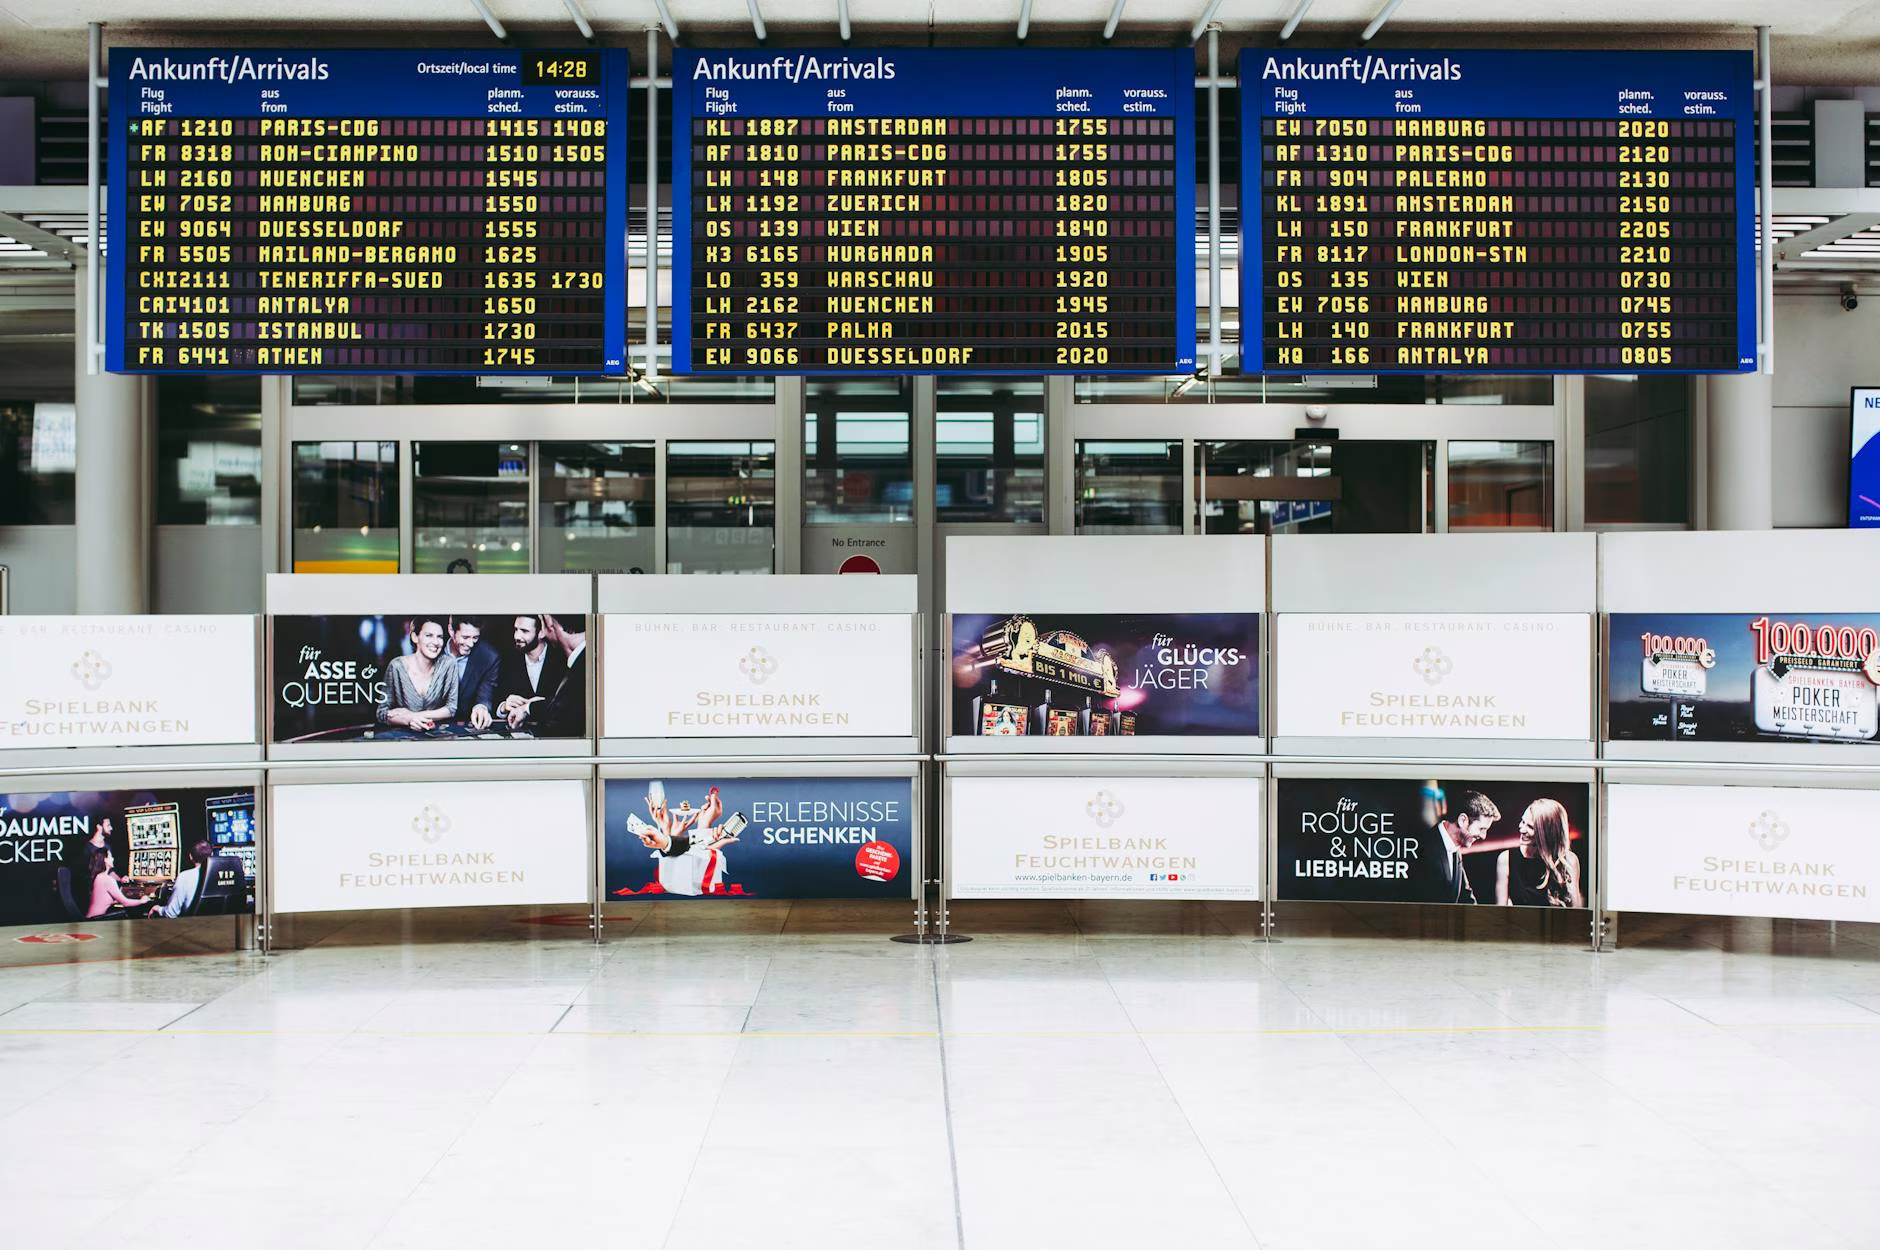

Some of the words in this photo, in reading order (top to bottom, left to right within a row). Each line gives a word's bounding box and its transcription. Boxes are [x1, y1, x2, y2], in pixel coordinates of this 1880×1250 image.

[129, 55, 329, 82] Ankunft/Arrivals
[417, 61, 489, 76] Ortszeit/local
[492, 62, 517, 75] time
[536, 61, 587, 78] 14:28
[693, 54, 896, 82] Ankunft/Arrivals
[1262, 55, 1462, 82] Ankunft/Arrivals
[141, 86, 165, 102] Flug
[261, 89, 280, 99] aus
[487, 87, 525, 101] planm.
[554, 89, 600, 99] vorauss.
[705, 87, 729, 101] Flug
[827, 89, 846, 98] aus
[1056, 86, 1093, 100] planm.
[1123, 89, 1168, 98] vorauss.
[1274, 86, 1298, 101] Flug
[1394, 89, 1414, 99] aus
[1618, 88, 1655, 103] planm.
[1683, 91, 1728, 101] vorauss.
[141, 101, 173, 116] Flight
[260, 101, 288, 113] from
[487, 101, 522, 113] sched.
[554, 101, 588, 113] estim.
[705, 101, 738, 116] Flight
[827, 100, 854, 112] from
[1056, 100, 1091, 112] sched.
[1123, 101, 1156, 112] estim.
[1275, 100, 1307, 115] Flight
[1395, 101, 1422, 113] from
[1618, 102, 1652, 114] sched.
[1683, 103, 1716, 115] estim.
[141, 119, 166, 137] AF
[181, 119, 233, 137] 1210
[261, 119, 377, 137] PARIS-CDG
[487, 119, 538, 137] 1415
[553, 119, 605, 137] 1408
[141, 144, 166, 161] FR
[181, 144, 231, 161] 8318
[260, 144, 417, 161] ROM-CIAMPINO
[487, 145, 538, 161] 1510
[553, 145, 605, 161] 1505
[707, 144, 731, 161] AF
[747, 144, 799, 161] 1810
[827, 144, 947, 161] PARIS-CDG
[1056, 144, 1107, 161] 1755
[1277, 169, 1301, 187] FR
[1329, 170, 1368, 187] 904
[1396, 170, 1486, 187] PALERMO
[1619, 171, 1669, 188] 2130
[140, 195, 165, 212] EW
[180, 195, 231, 212] 7052
[259, 195, 351, 213] HAMBURG
[486, 195, 537, 213] 1550
[707, 195, 731, 212] LX
[747, 195, 799, 212] 1192
[827, 194, 919, 212] ZUERICH
[1056, 194, 1107, 211] 1820
[140, 220, 165, 237] EW
[180, 220, 231, 238] 9064
[259, 220, 403, 238] DUESSELDORF
[485, 221, 537, 238] 1555
[706, 220, 731, 237] OS
[760, 220, 799, 237] 139
[827, 219, 879, 237] WIEN
[1057, 219, 1107, 237] 1840
[1277, 220, 1302, 237] LH
[1331, 220, 1368, 237] 150
[1396, 220, 1513, 238] FRANKFURT
[1620, 221, 1670, 238] 2205
[1277, 245, 1302, 263] FR
[1317, 245, 1369, 263] 8117
[1397, 245, 1527, 263] LONDON-STN
[1620, 246, 1671, 263] 2210
[140, 271, 229, 288] CXI2111
[259, 271, 443, 289] TENERIFFA-SUED
[485, 271, 536, 289] 1635
[551, 272, 603, 289] 1730
[1278, 296, 1303, 313] EW
[1318, 296, 1369, 313] 7056
[1397, 296, 1488, 313] HAMBURG
[1621, 296, 1671, 313] 0745
[706, 322, 731, 339] FR
[747, 322, 798, 339] 6437
[827, 322, 893, 339] PALMA
[1057, 321, 1108, 339] 2015
[139, 347, 163, 364] FR
[179, 347, 229, 365] 6441
[257, 347, 321, 365] ATHEN
[484, 348, 535, 365] 1745
[832, 537, 845, 548] No
[847, 537, 886, 548] Entrance
[1152, 632, 1174, 651] für
[1751, 616, 1878, 664] 100.000
[299, 645, 321, 664] für
[1157, 643, 1247, 666] GLÜCKS-
[1778, 655, 1813, 667] PREISGELD
[1816, 658, 1860, 669] GARANTIERT
[303, 660, 357, 681] ASSE
[361, 664, 378, 680] &
[1035, 659, 1057, 677] BIS
[1128, 664, 1209, 690] JÄGER
[1662, 668, 1688, 681] POKER
[282, 681, 389, 708] QUEENS
[696, 691, 820, 707] SPIELBANK
[1369, 691, 1497, 709] SPIELBANK
[1792, 686, 1841, 708] POKER
[25, 699, 159, 716] SPIELBANK
[1772, 705, 1859, 726] MEISTERSCHAFT
[667, 711, 850, 726] FEUCHTWANGEN
[1340, 711, 1526, 728] FEUCHTWANGEN
[752, 800, 899, 823] ERLEBNISSE
[1336, 796, 1358, 815] für
[1301, 812, 1395, 835] ROUGE
[763, 826, 877, 845] SCHENKEN
[1043, 834, 1168, 850] SPIELBANK
[1330, 836, 1347, 859] &
[1354, 837, 1419, 859] NOIR
[368, 851, 496, 868] SPIELBANK
[1014, 854, 1197, 869] FEUCHTWANGEN
[1703, 856, 1836, 877] SPIELBANK
[1014, 873, 1133, 883] www.spielbanken-bayern.de
[1295, 859, 1409, 880] LIEBHABER
[339, 870, 525, 888] FEUCHTWANGEN
[1672, 875, 1868, 899] FEUCHTWANGEN
